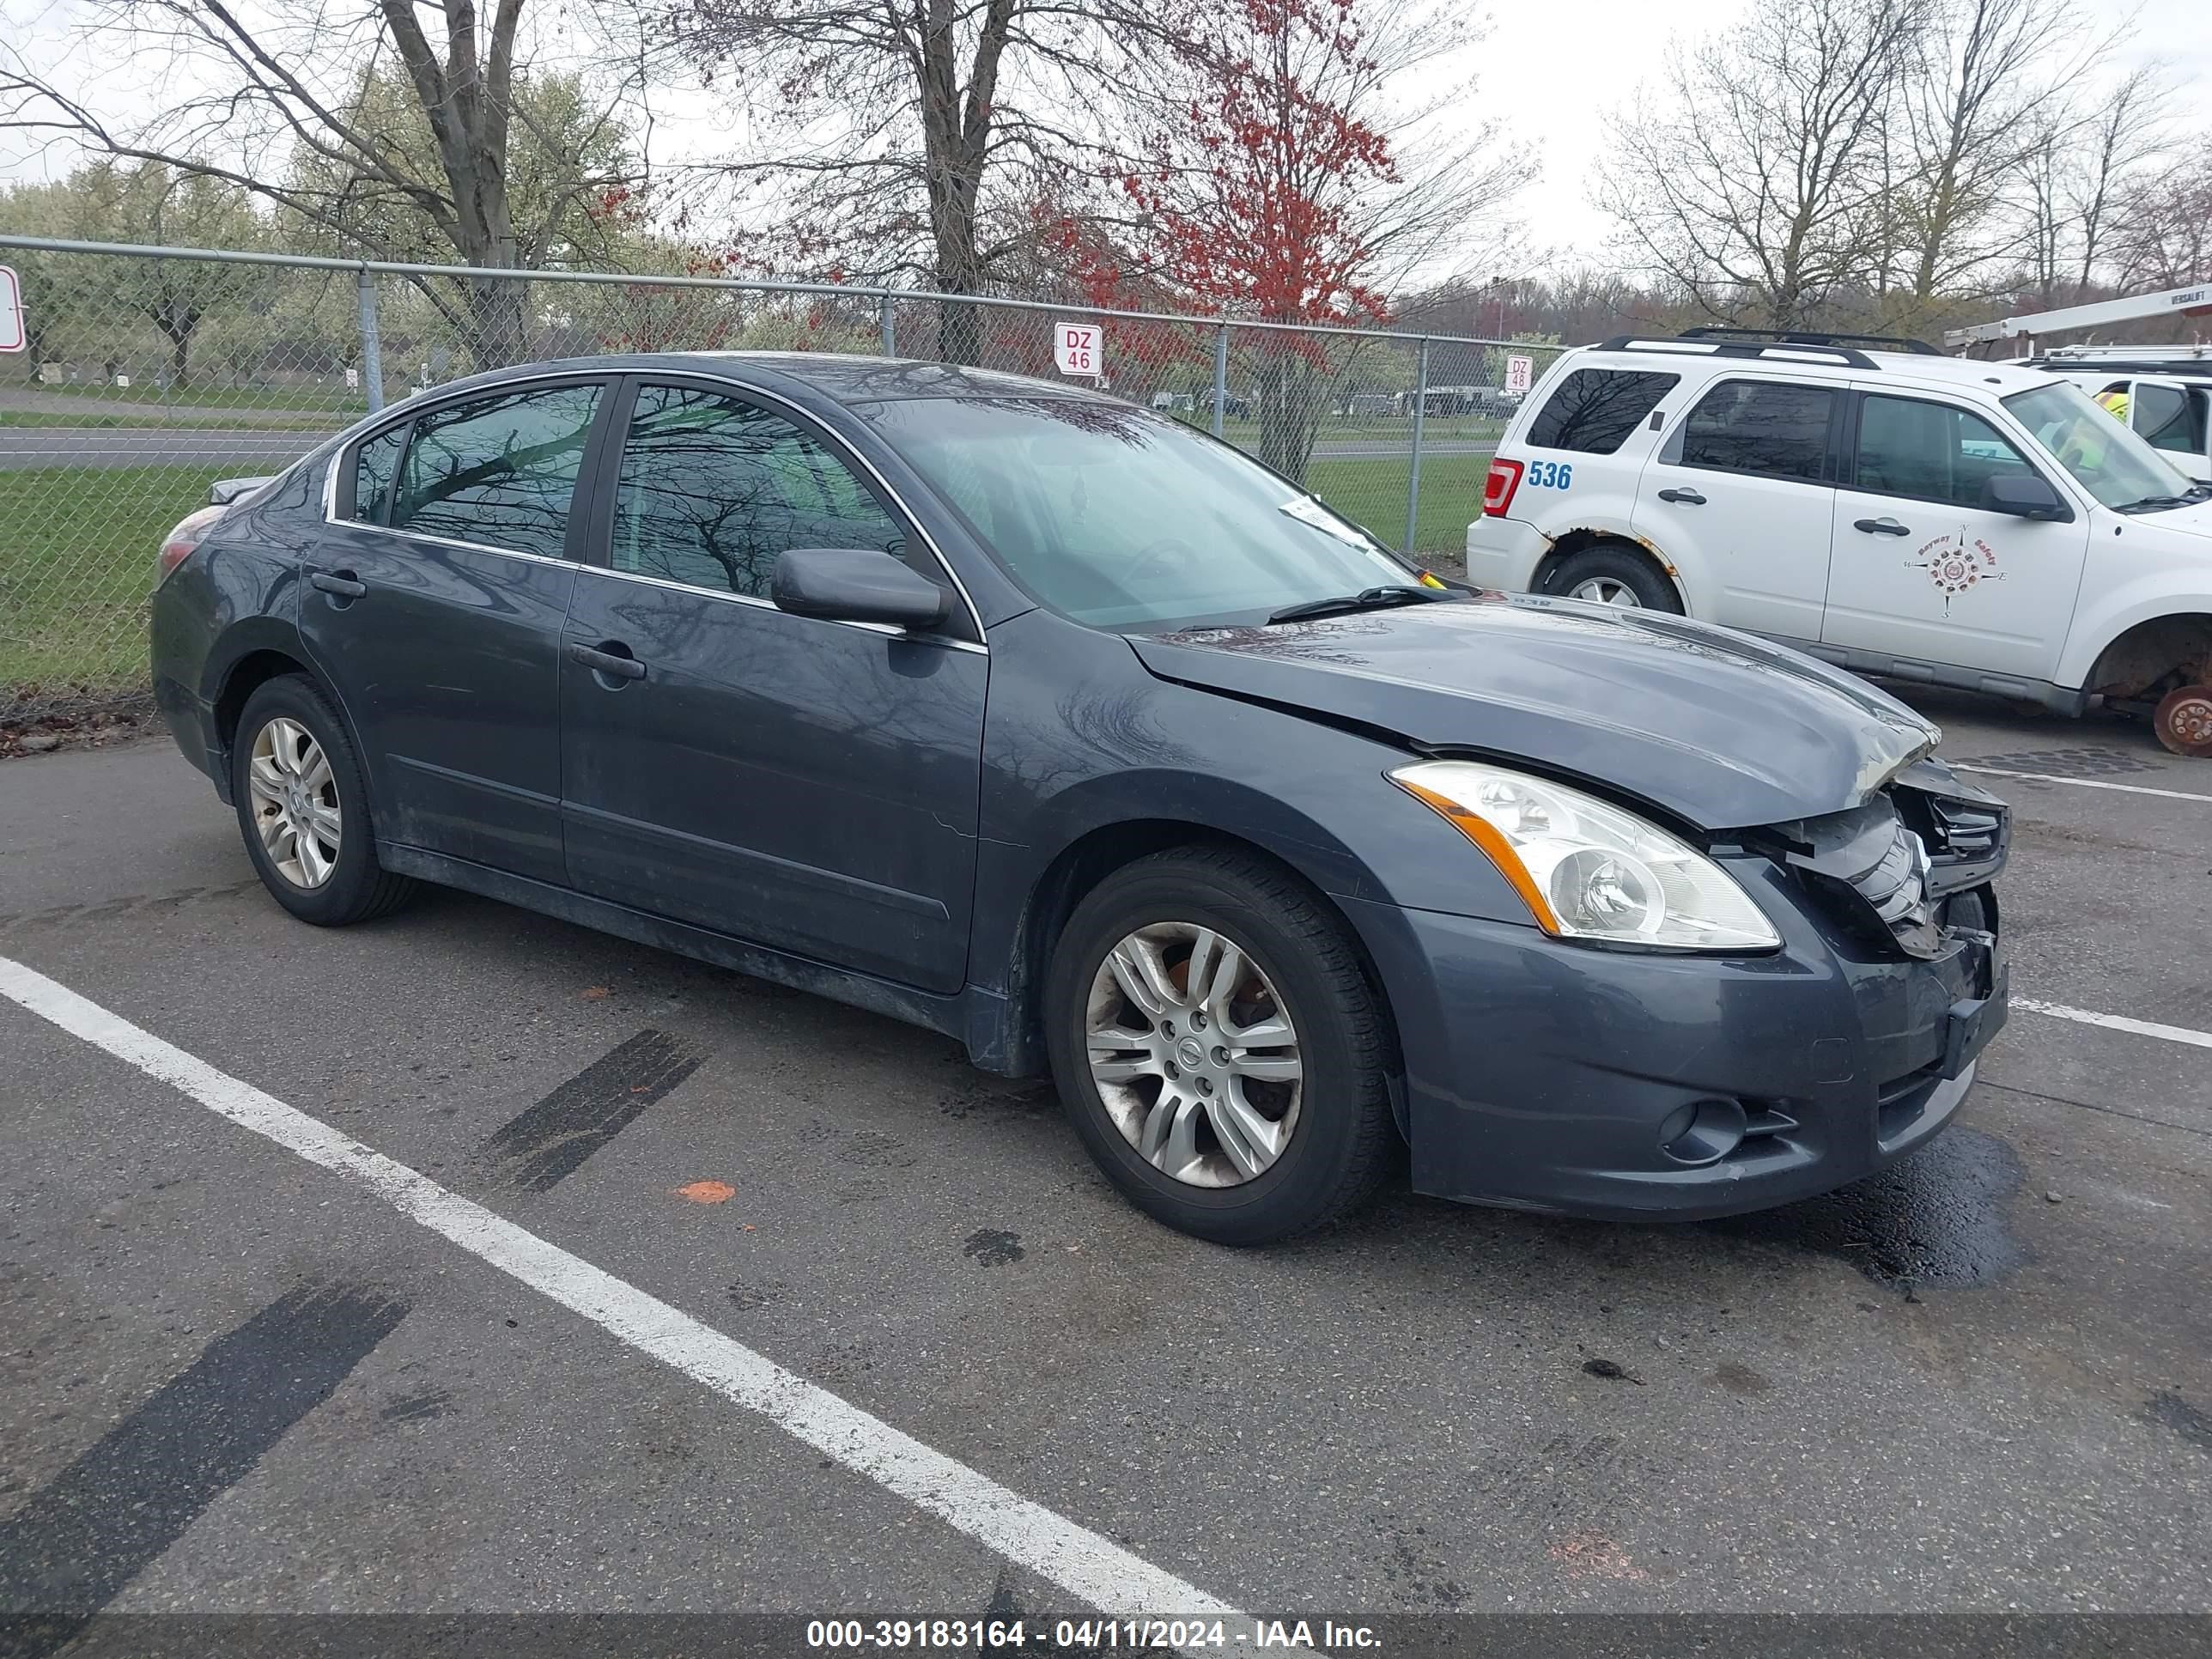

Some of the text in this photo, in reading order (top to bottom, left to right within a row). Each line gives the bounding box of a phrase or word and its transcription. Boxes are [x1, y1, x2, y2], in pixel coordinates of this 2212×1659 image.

[2171, 290, 2206, 305] VERSALIFT
[1066, 330, 1092, 349] DZ
[1067, 351, 1091, 369] 46
[1512, 360, 1528, 374] DZ
[1511, 374, 1525, 387] 48
[1528, 460, 1573, 490] 536
[1974, 538, 1997, 567] Safety
